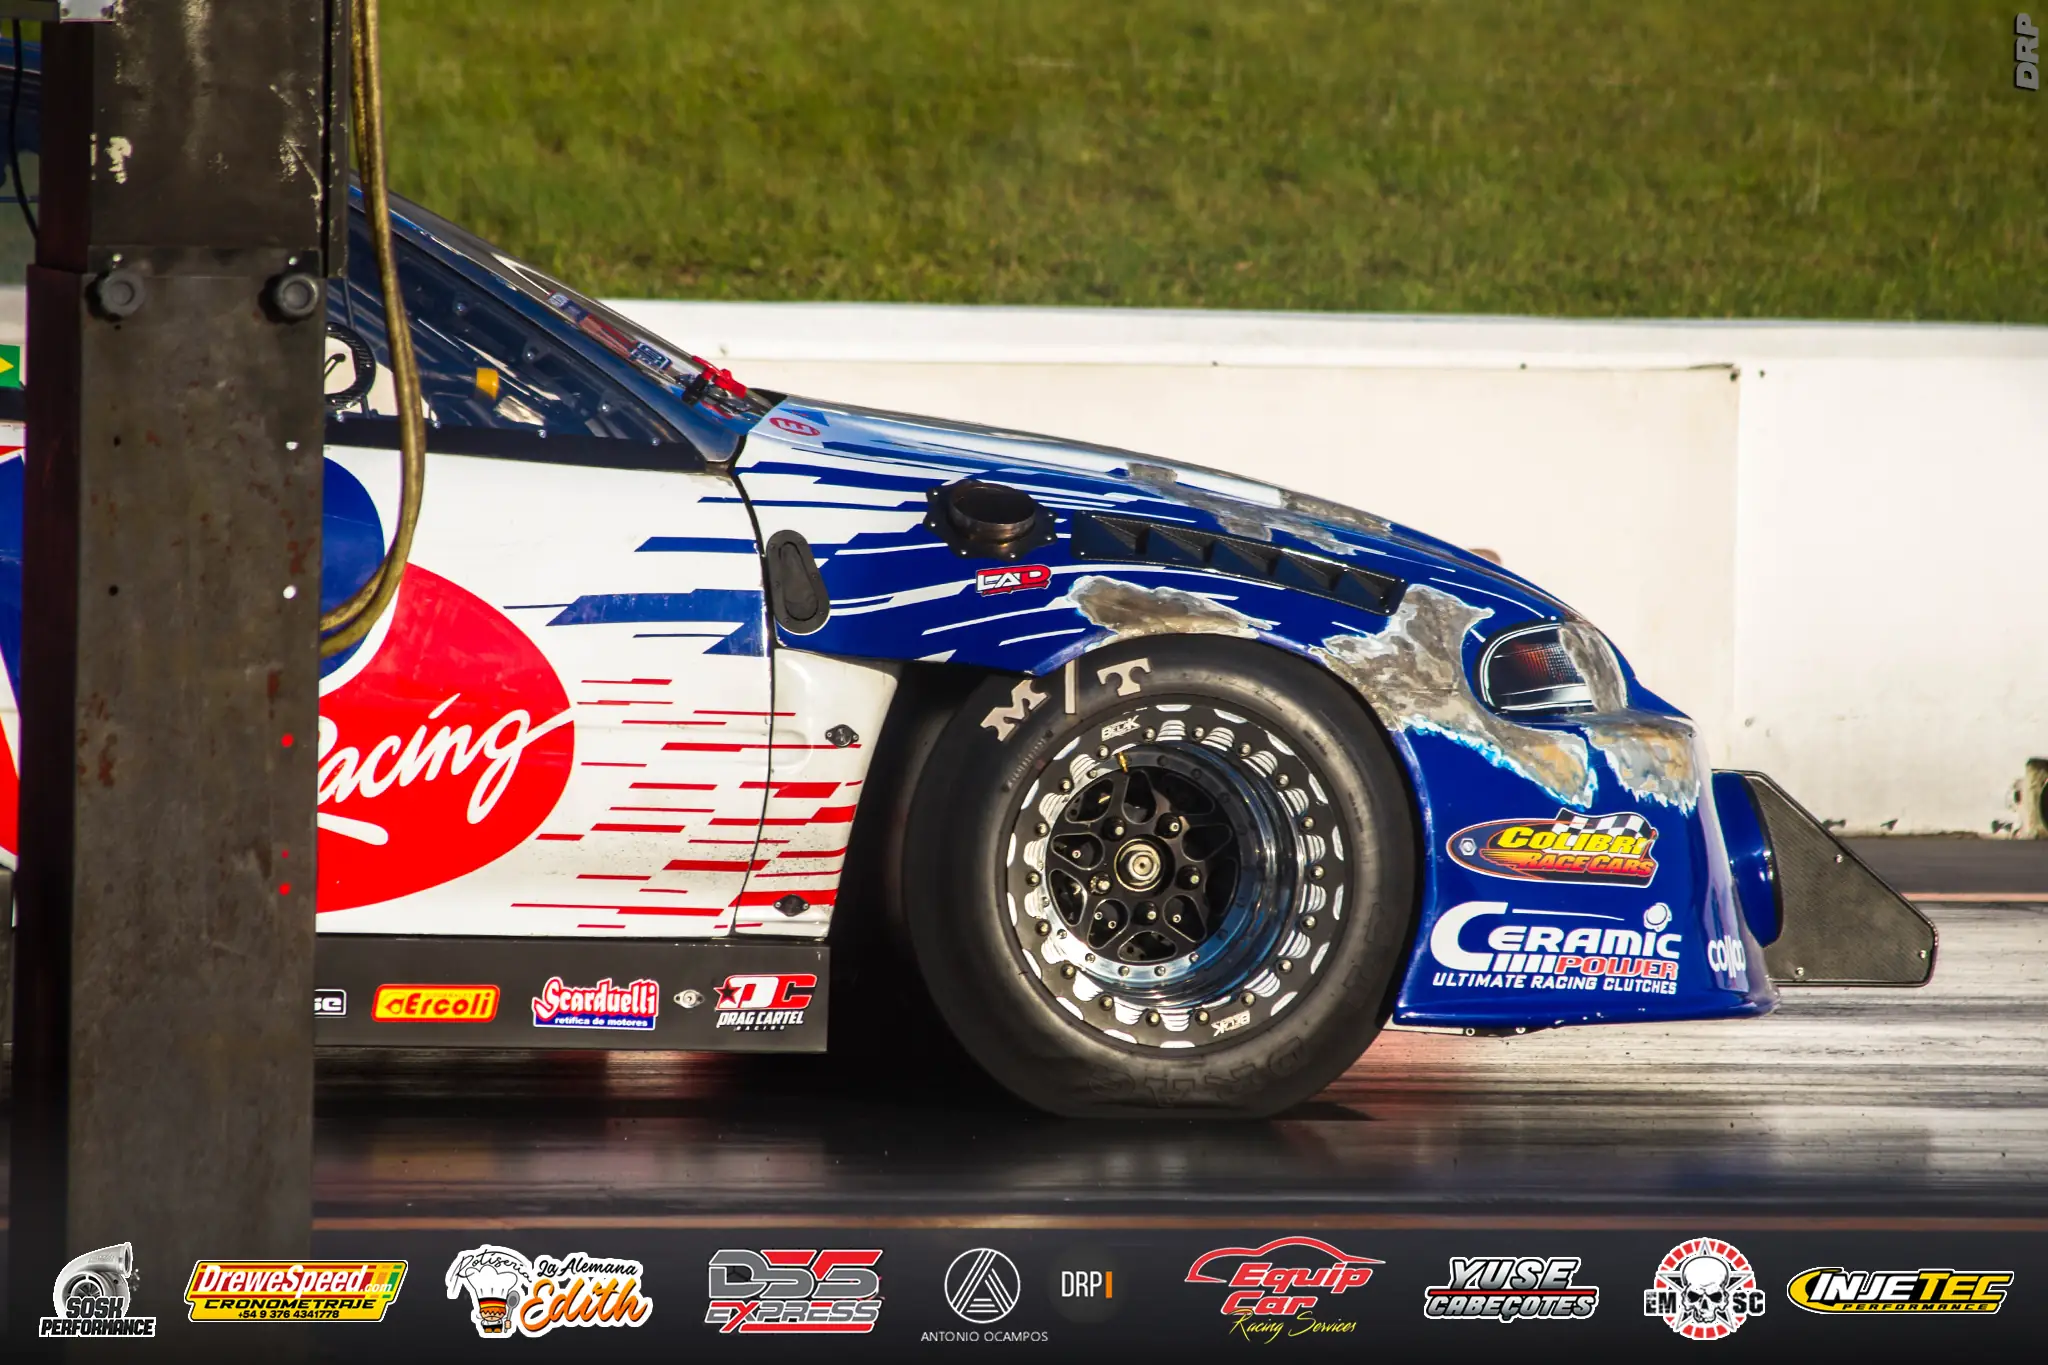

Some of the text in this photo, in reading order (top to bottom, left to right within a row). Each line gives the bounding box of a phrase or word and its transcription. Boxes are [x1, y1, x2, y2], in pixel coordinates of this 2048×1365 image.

[1497, 826, 1649, 855] COLIBRI
[1517, 852, 1654, 876] RACE CARS
[1555, 956, 1678, 980] POWER
[1433, 972, 1677, 995] ULTIMATE RACING CLUTCHES
[533, 977, 658, 1019] Scarduelli
[607, 1018, 648, 1026] motores
[716, 1010, 804, 1028] DRAG CARTEL
